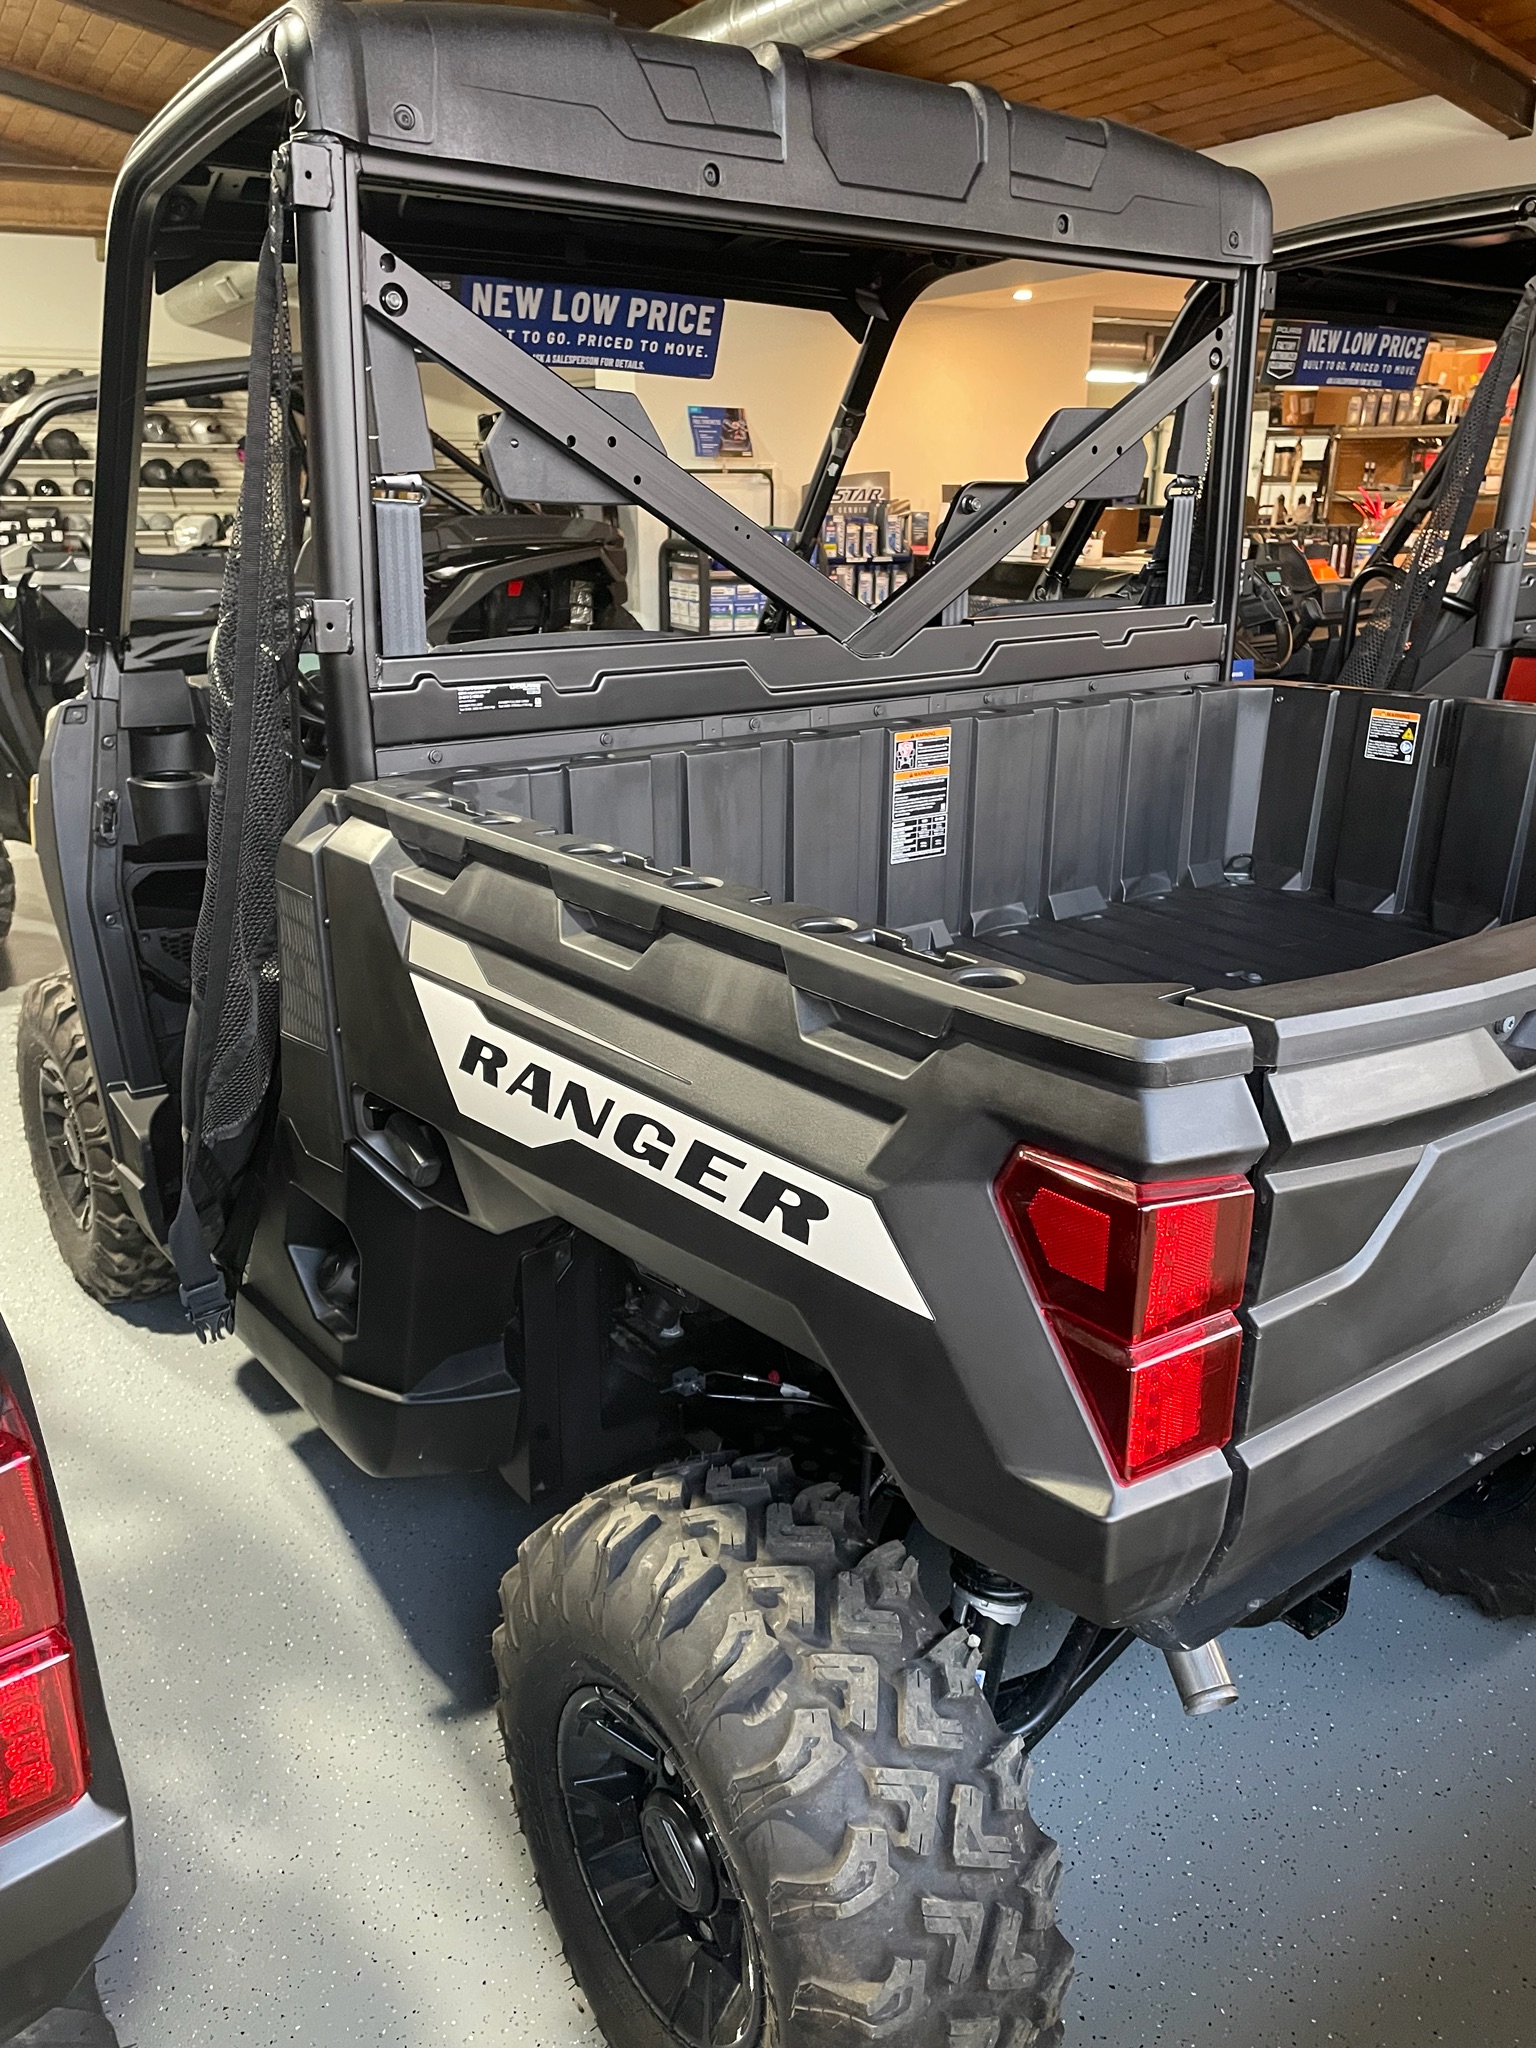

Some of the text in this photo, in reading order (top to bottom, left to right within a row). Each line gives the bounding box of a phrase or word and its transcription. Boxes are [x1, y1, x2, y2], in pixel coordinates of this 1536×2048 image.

[471, 282, 715, 336] NEW LOW PRICE
[522, 330, 541, 344] TO
[546, 331, 571, 346] GO.
[577, 333, 634, 350] PRICED
[640, 339, 659, 353] TO
[664, 342, 709, 359] MOVE.
[1307, 328, 1427, 360] NEW LOW PRICE
[552, 355, 599, 366] SALESPERSON
[600, 357, 615, 367] FOR
[615, 358, 646, 370] DETAILS.
[1303, 360, 1325, 370] BUILT
[1325, 361, 1335, 371] TO
[1349, 362, 1380, 373] PRICED
[1382, 364, 1393, 374] TO
[459, 1035, 829, 1245] RANGER
